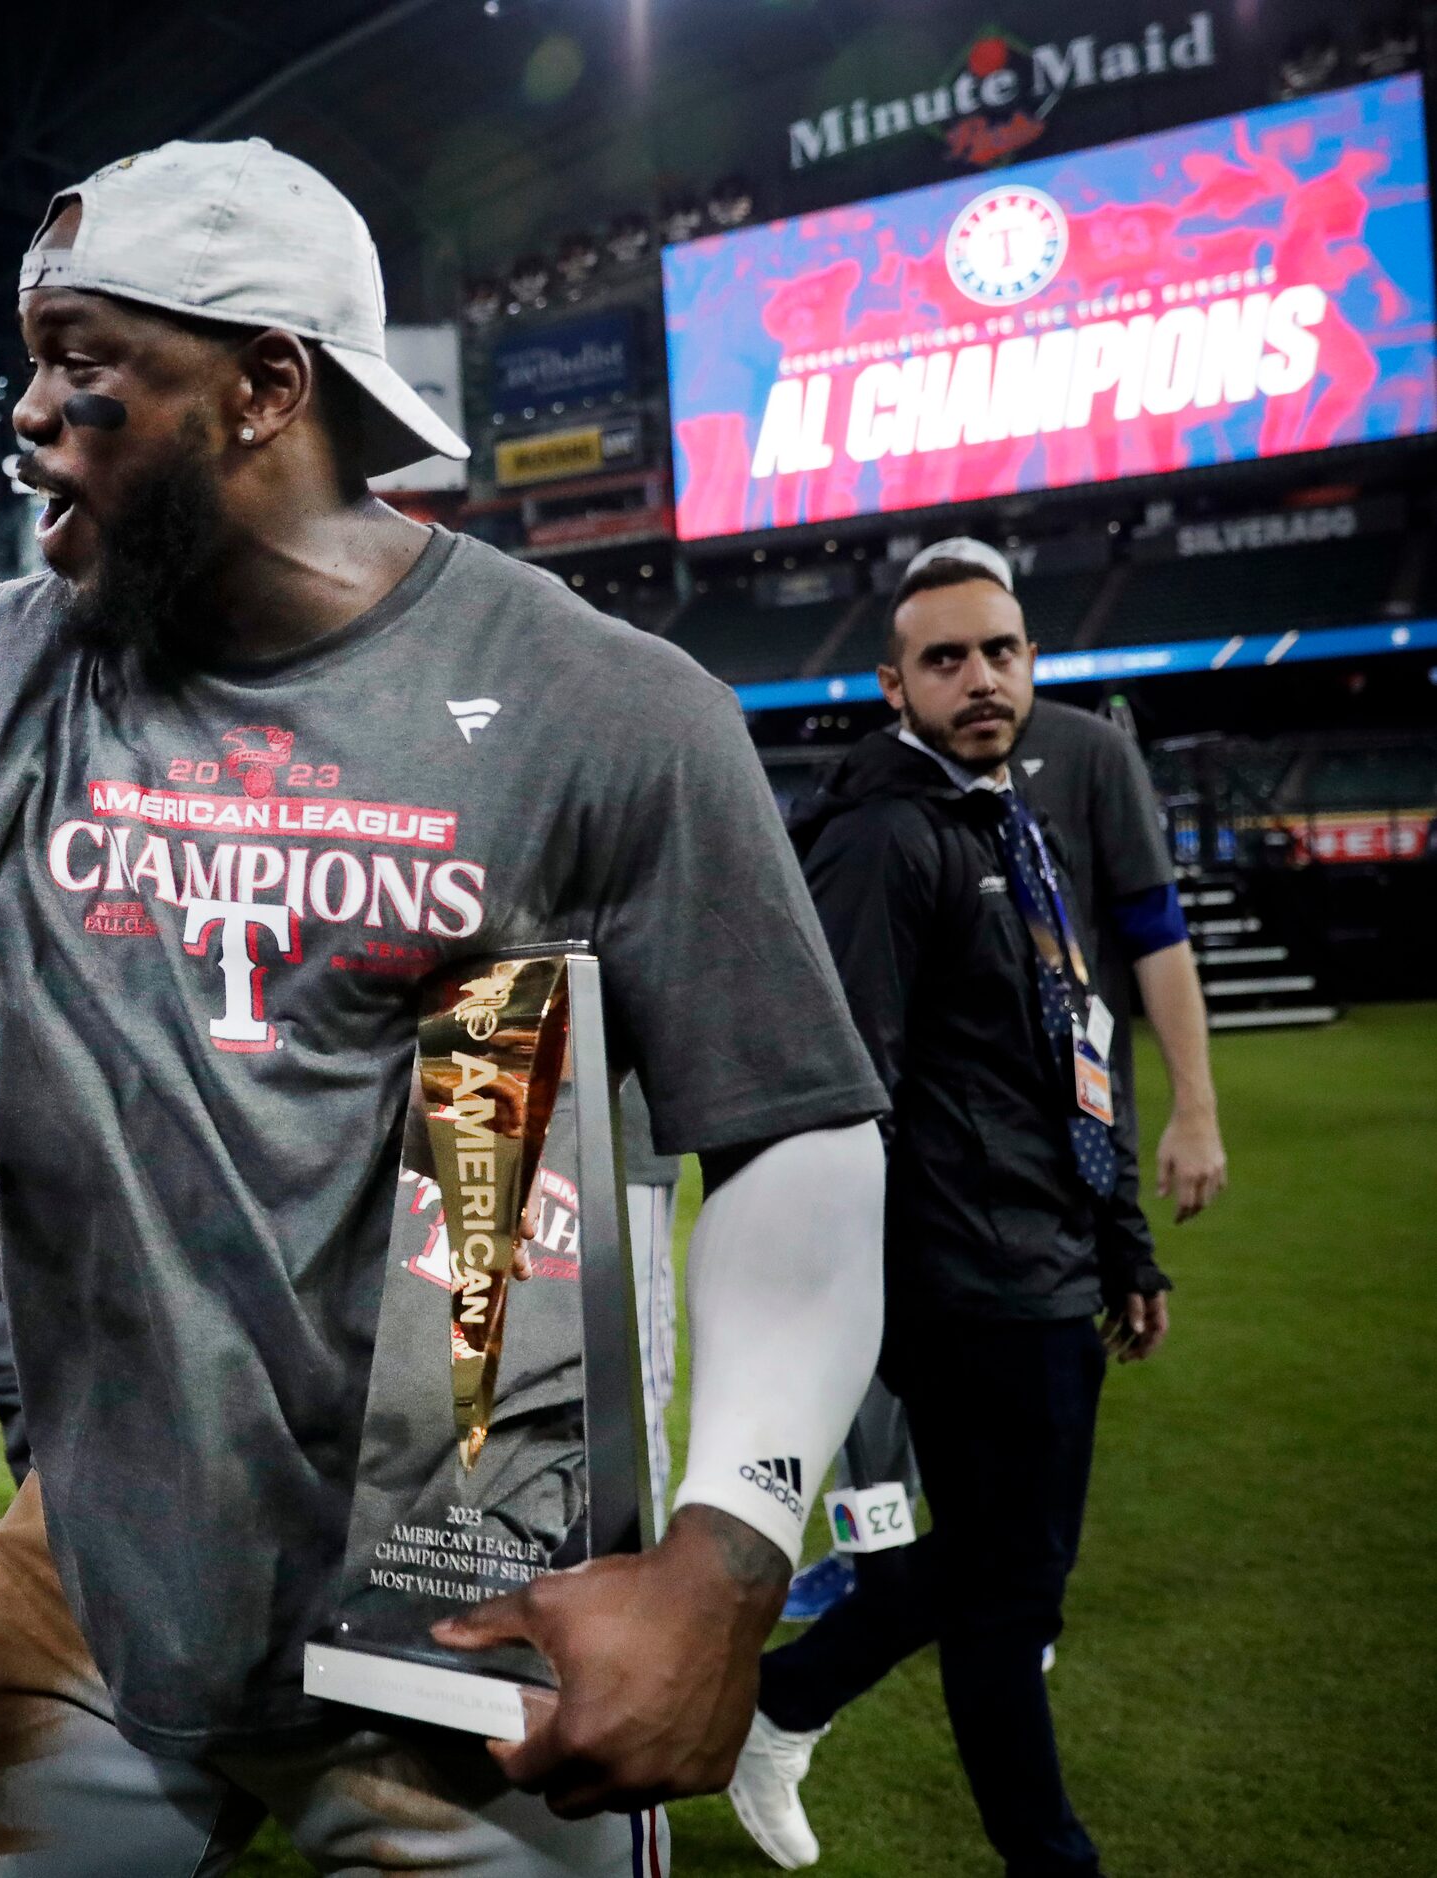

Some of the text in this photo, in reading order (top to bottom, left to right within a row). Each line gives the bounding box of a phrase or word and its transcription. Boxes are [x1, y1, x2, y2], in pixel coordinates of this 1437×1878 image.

[788, 11, 1216, 170] Minute Maid
[751, 284, 1328, 479] AL CHAMPIONS
[1177, 505, 1358, 557] SILVERADO
[166, 757, 342, 789] 20 23
[93, 788, 449, 844] AMERICAN LEAGUE
[48, 818, 487, 939] CHAMPIONS
[182, 898, 304, 1055] T
[450, 1050, 499, 1325] AMERICAN
[444, 1505, 483, 1527] 2023
[739, 1464, 804, 1523] adidas
[866, 1501, 904, 1536] 23
[375, 1542, 497, 1576] CHAMPIONSHIP
[391, 1523, 539, 1563] AMERICAN LEAGUE
[369, 1568, 495, 1602] MOST VALUABLE
